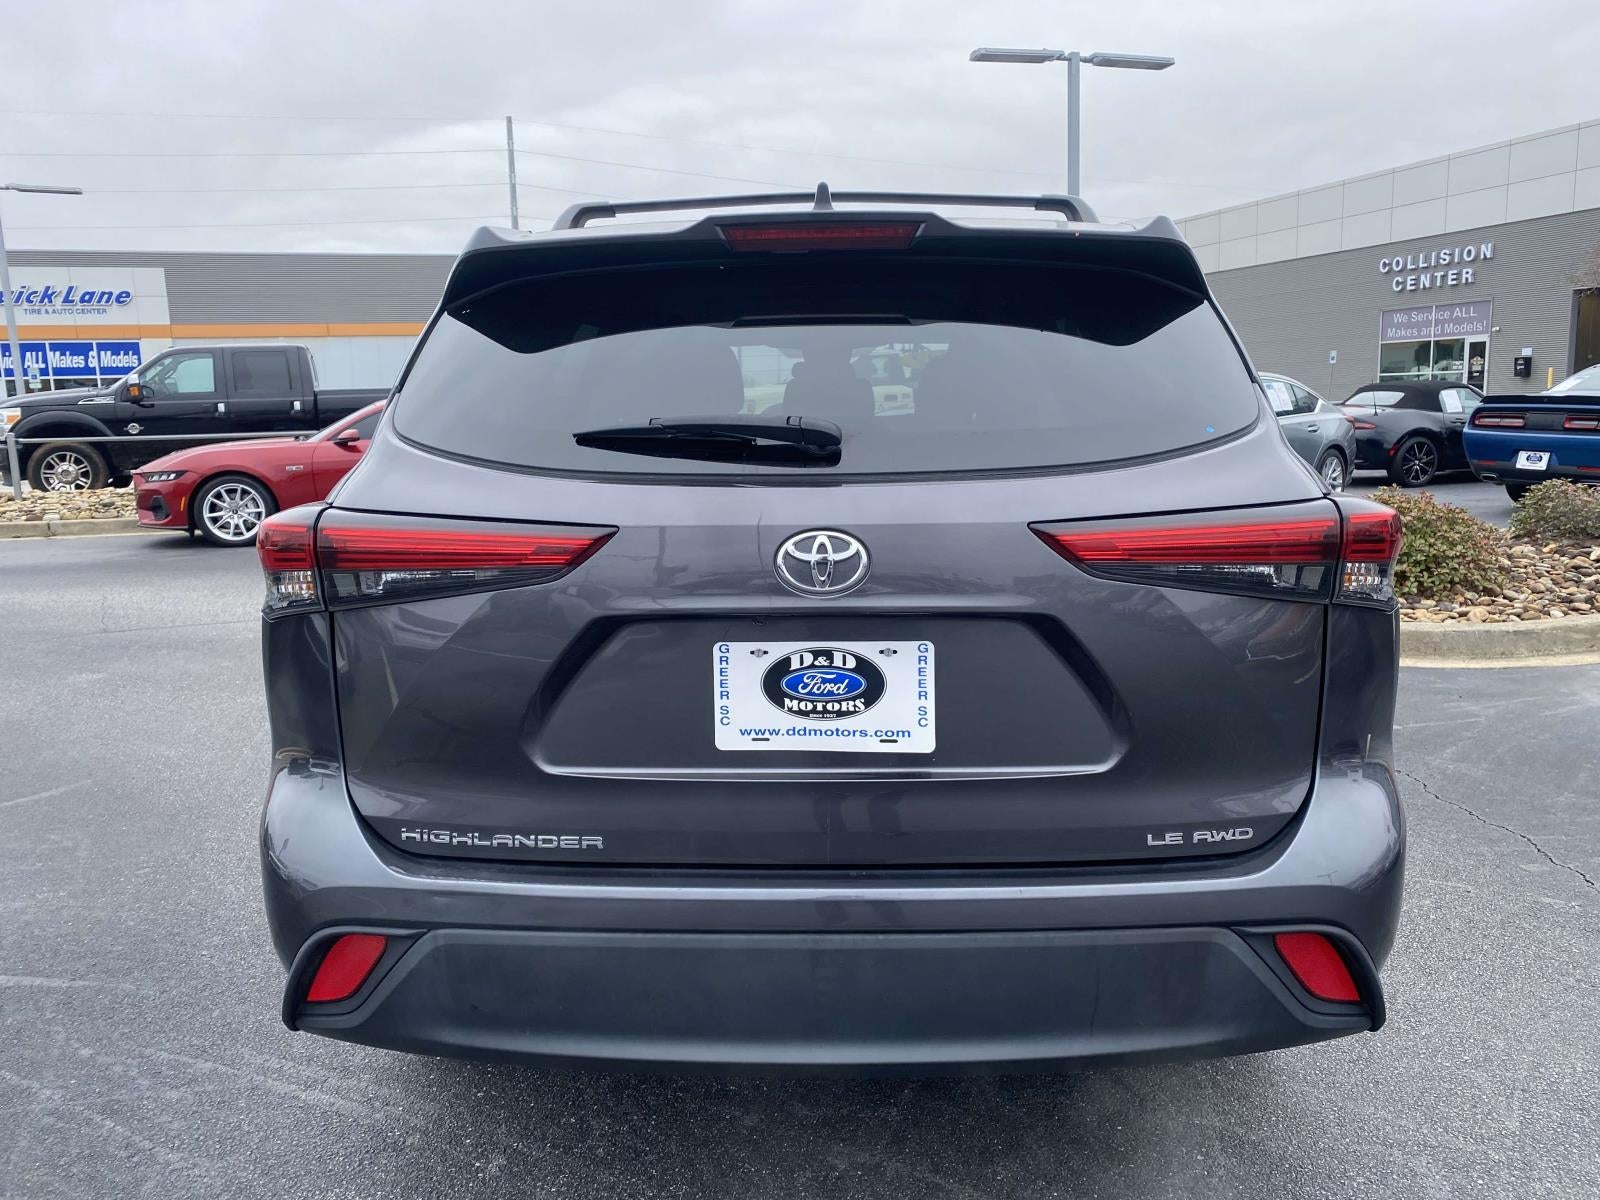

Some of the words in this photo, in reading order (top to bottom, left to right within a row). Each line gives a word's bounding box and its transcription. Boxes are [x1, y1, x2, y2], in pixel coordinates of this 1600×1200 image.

[1379, 242, 1493, 273] COLLISION
[1392, 268, 1474, 291] CENTER
[61, 284, 132, 305] Lane
[1393, 312, 1409, 323] We
[1411, 309, 1450, 322] Service
[1453, 305, 1478, 319] ALL
[1387, 326, 1418, 338] Makes
[1420, 323, 1441, 336] and
[1444, 319, 1487, 334] Models!
[24, 351, 46, 369] ALL
[49, 351, 85, 368] Makes
[87, 350, 97, 368] &
[100, 350, 139, 368] Models
[788, 650, 857, 671] D&D
[719, 643, 730, 701] GREER
[917, 642, 929, 701] GREER
[797, 672, 850, 694] Ford
[719, 704, 731, 726] SC
[783, 697, 866, 712] MOTORS
[917, 705, 929, 728] SC
[738, 726, 912, 738] www.ddmotors.com
[400, 828, 604, 849] HIGHLANDER
[1147, 832, 1184, 846] LE
[1192, 827, 1254, 844] AWD
